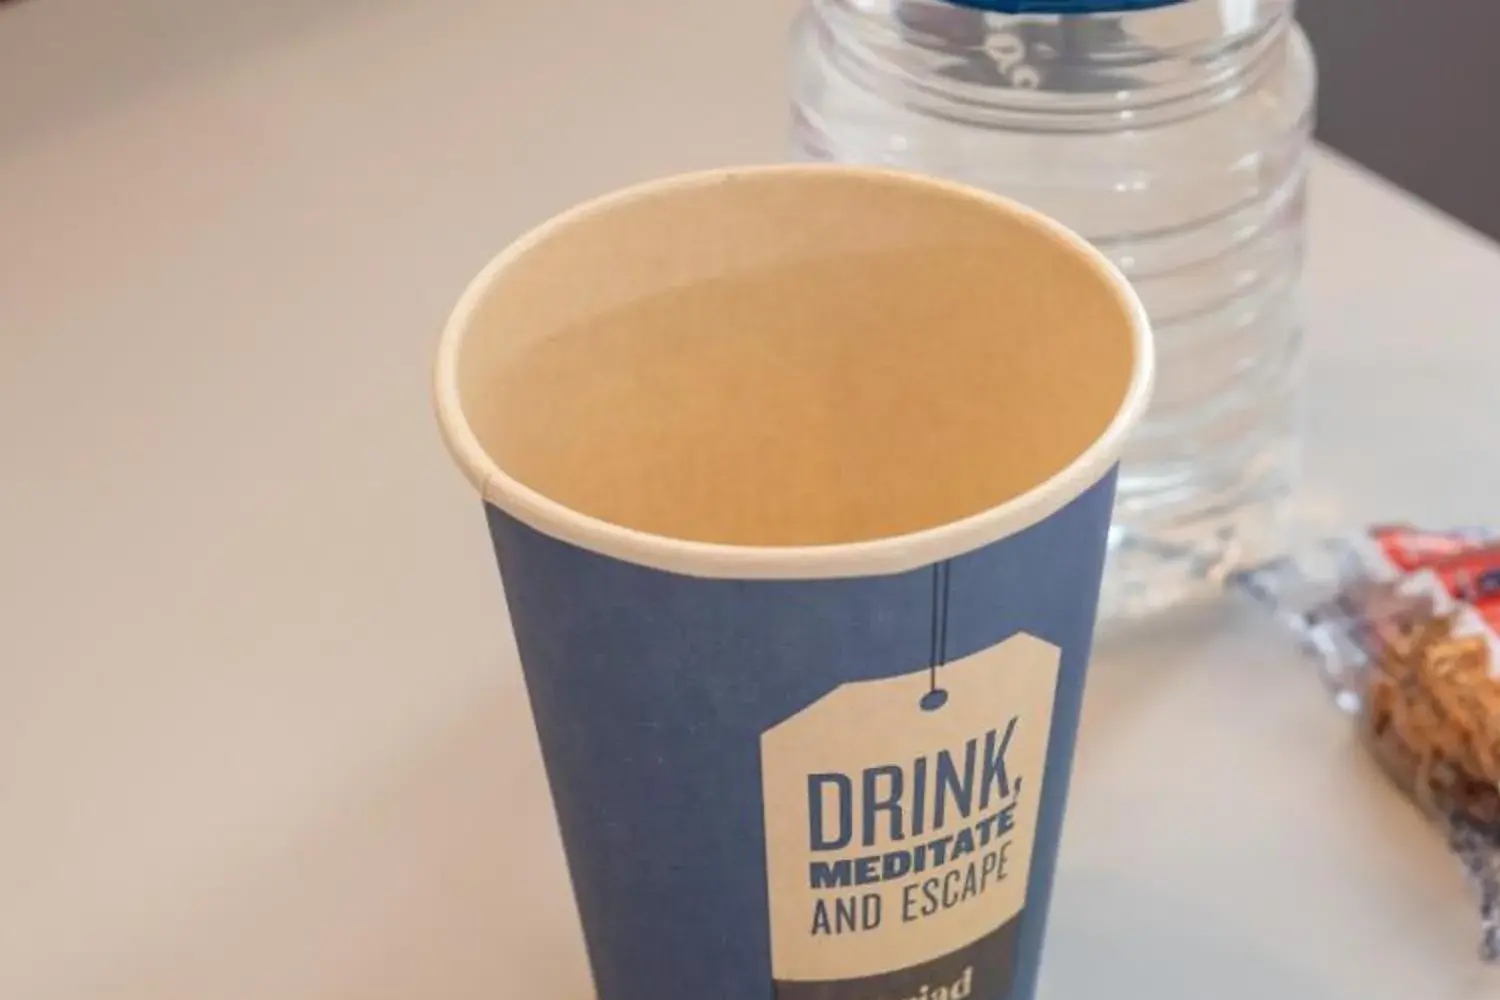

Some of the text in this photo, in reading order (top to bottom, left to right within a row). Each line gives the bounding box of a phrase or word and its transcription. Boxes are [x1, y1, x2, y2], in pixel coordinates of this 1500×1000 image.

[807, 716, 1023, 852] DRINK,
[810, 802, 1019, 889] MEDITATE
[810, 839, 1012, 937] AND ESCAPE
